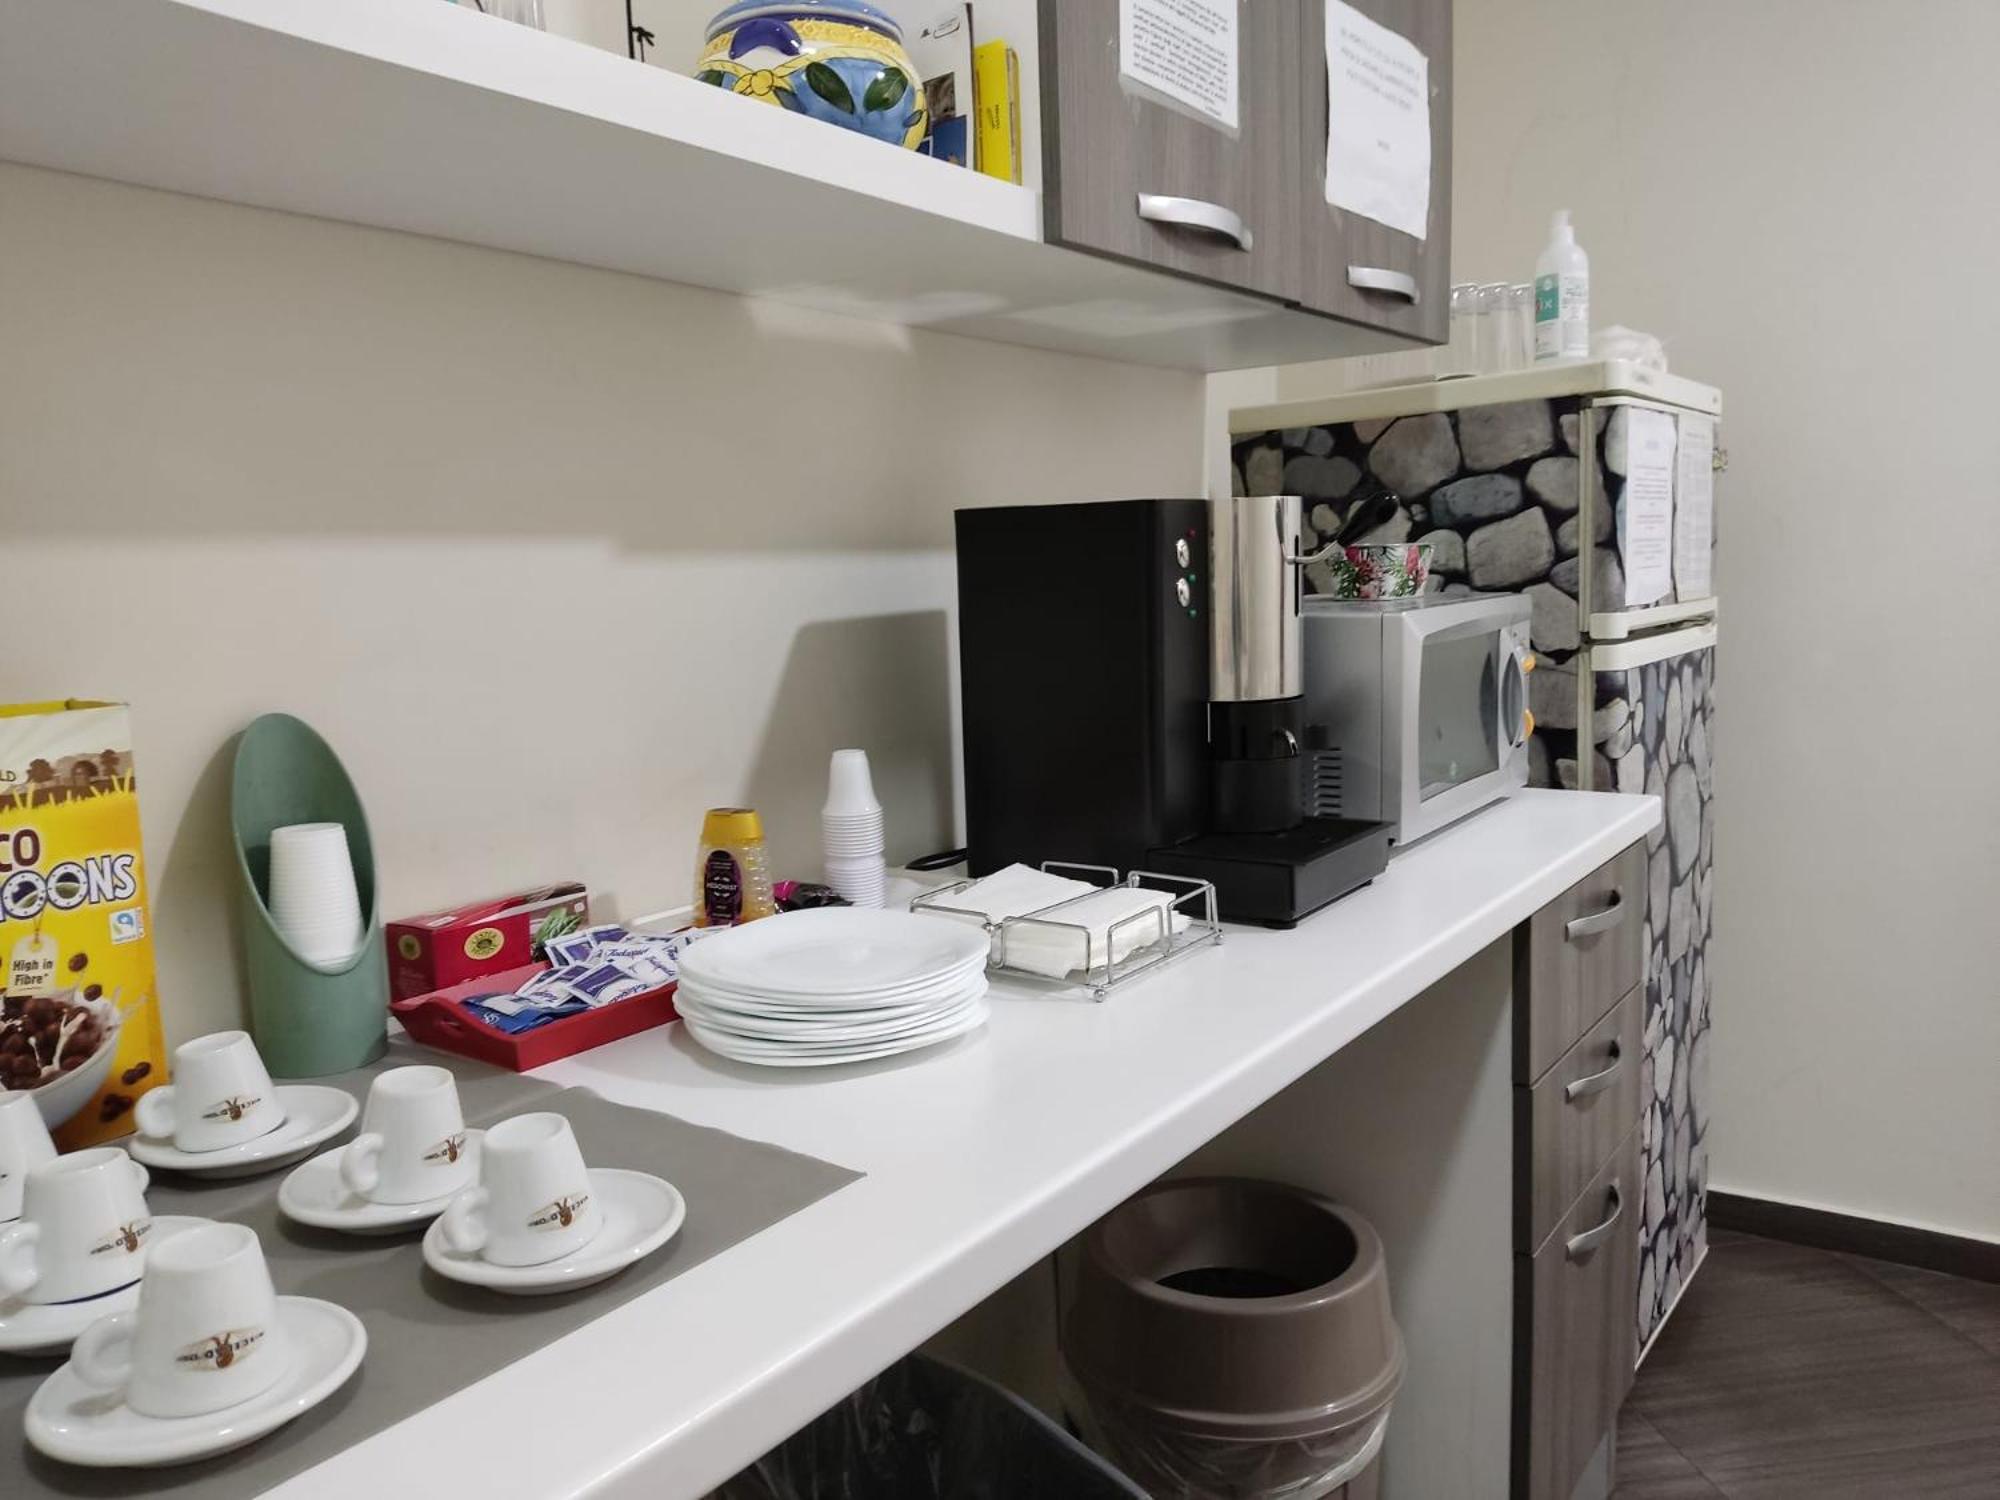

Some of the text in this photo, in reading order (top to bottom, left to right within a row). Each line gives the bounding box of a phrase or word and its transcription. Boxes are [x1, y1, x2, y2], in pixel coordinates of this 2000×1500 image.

[0, 854, 137, 922] OONS
[13, 958, 54, 972] High in
